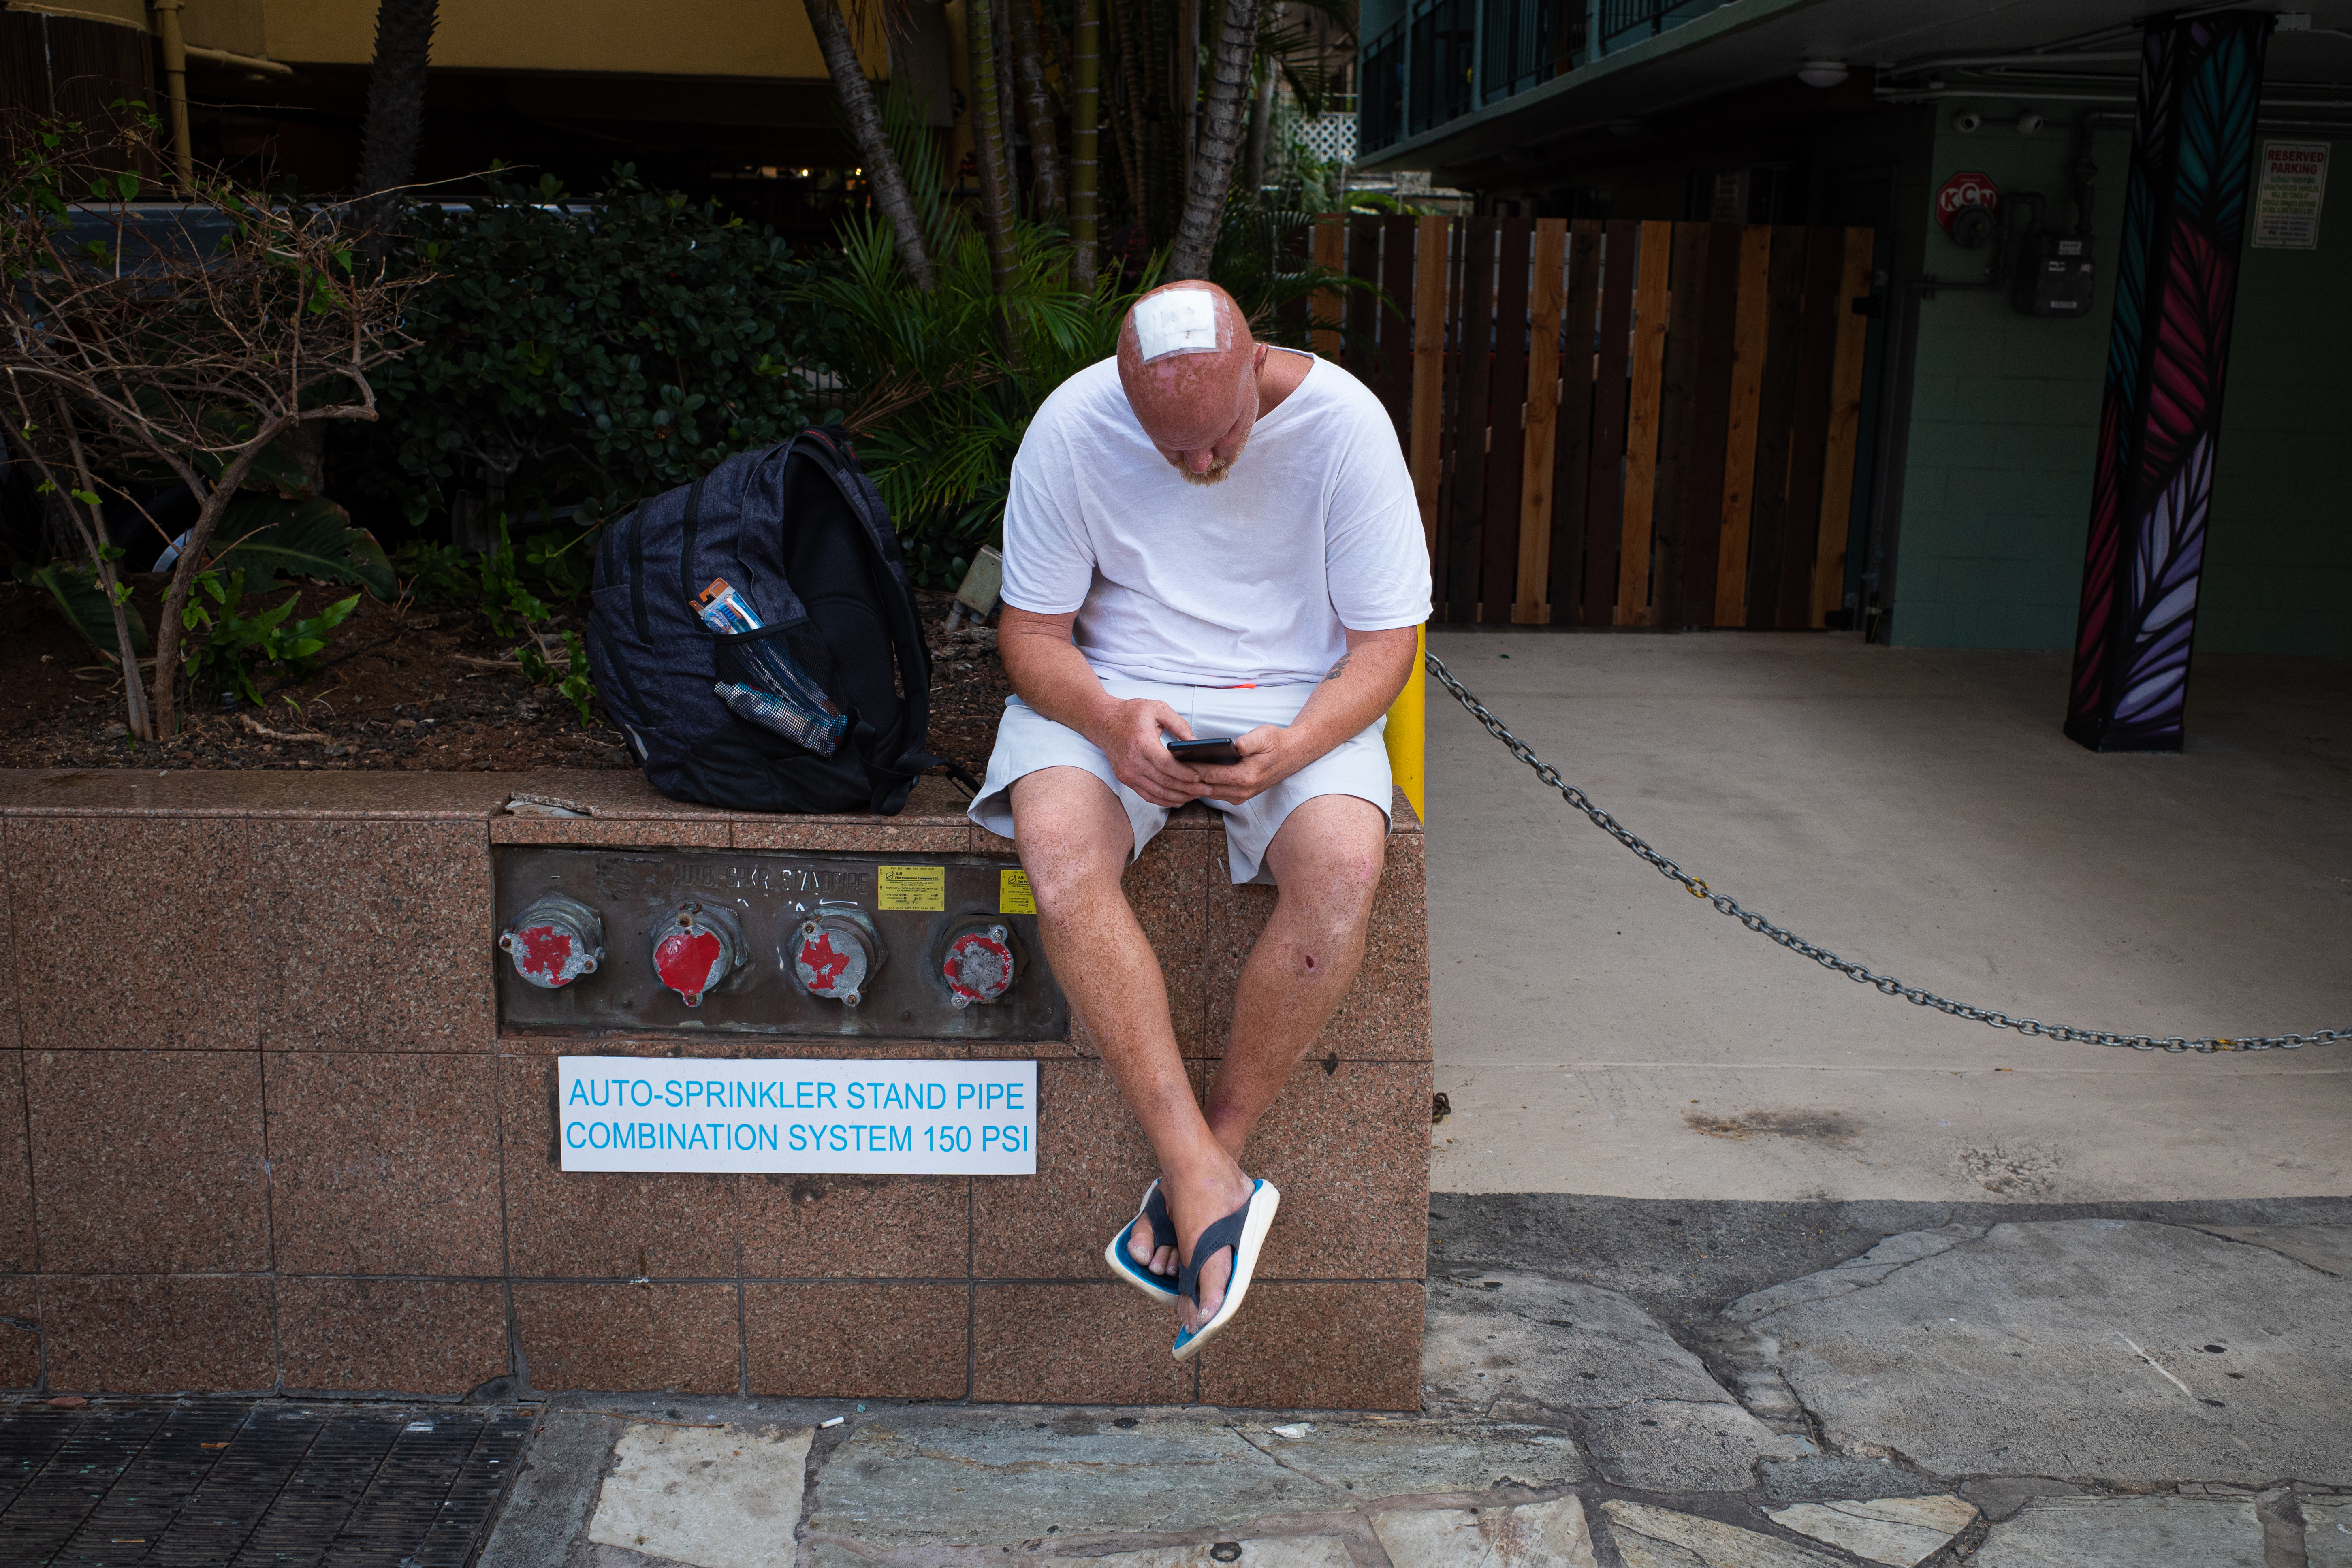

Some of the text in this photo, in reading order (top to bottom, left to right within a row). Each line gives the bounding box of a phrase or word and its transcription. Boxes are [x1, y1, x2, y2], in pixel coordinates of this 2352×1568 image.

[2267, 150, 2324, 162] RESERVED
[2271, 162, 2318, 175] PARKING
[781, 869, 870, 895] STANDPIPE
[568, 1079, 1024, 1109] AUTO-SPRINKLER STAND PIPE
[566, 1121, 1028, 1152] COMBINATION SYSTEM 150 PSI
